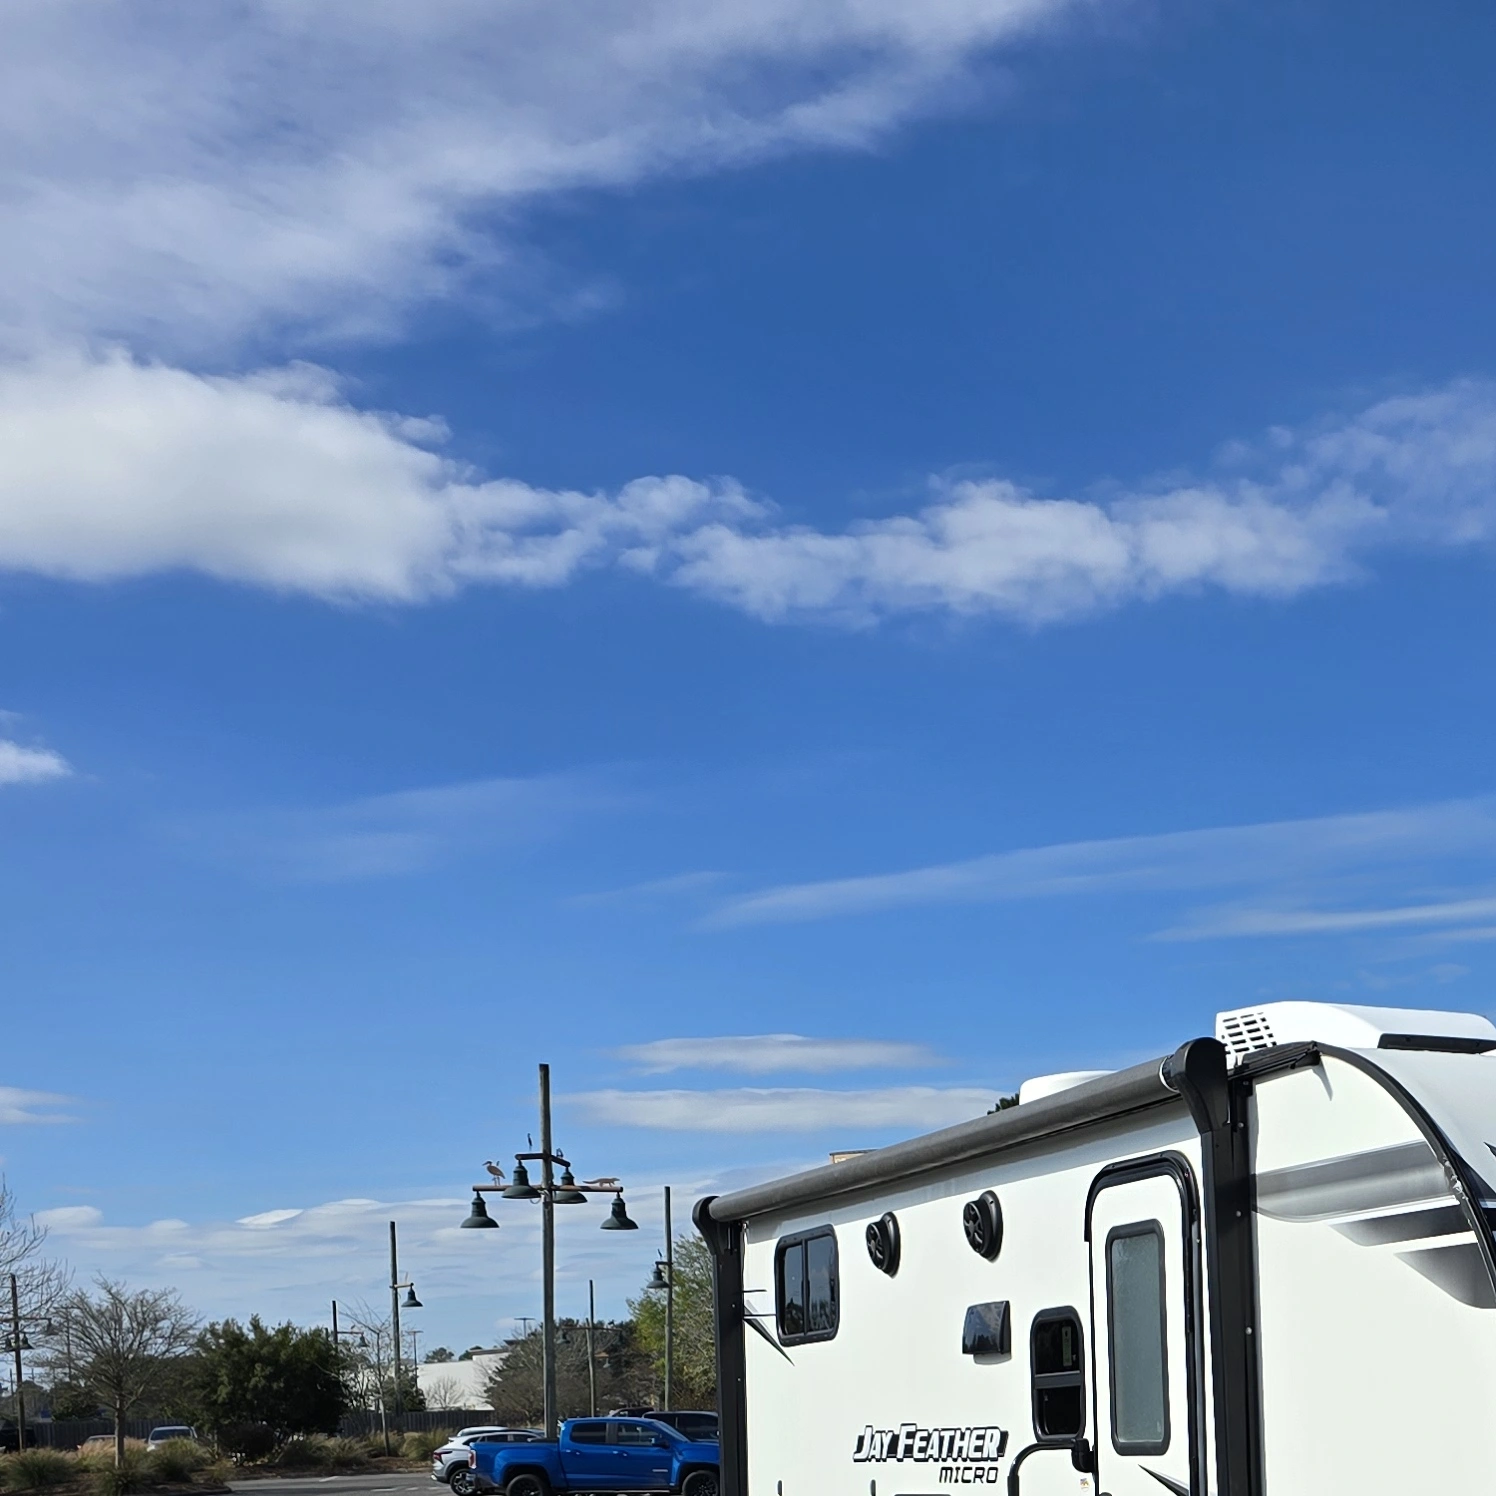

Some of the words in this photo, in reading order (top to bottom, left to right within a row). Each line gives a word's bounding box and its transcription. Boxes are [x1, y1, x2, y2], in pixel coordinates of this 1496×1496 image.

[853, 1425, 894, 1462] JAY
[897, 1423, 1001, 1462] FEATHER
[939, 1466, 999, 1484] MICRO
